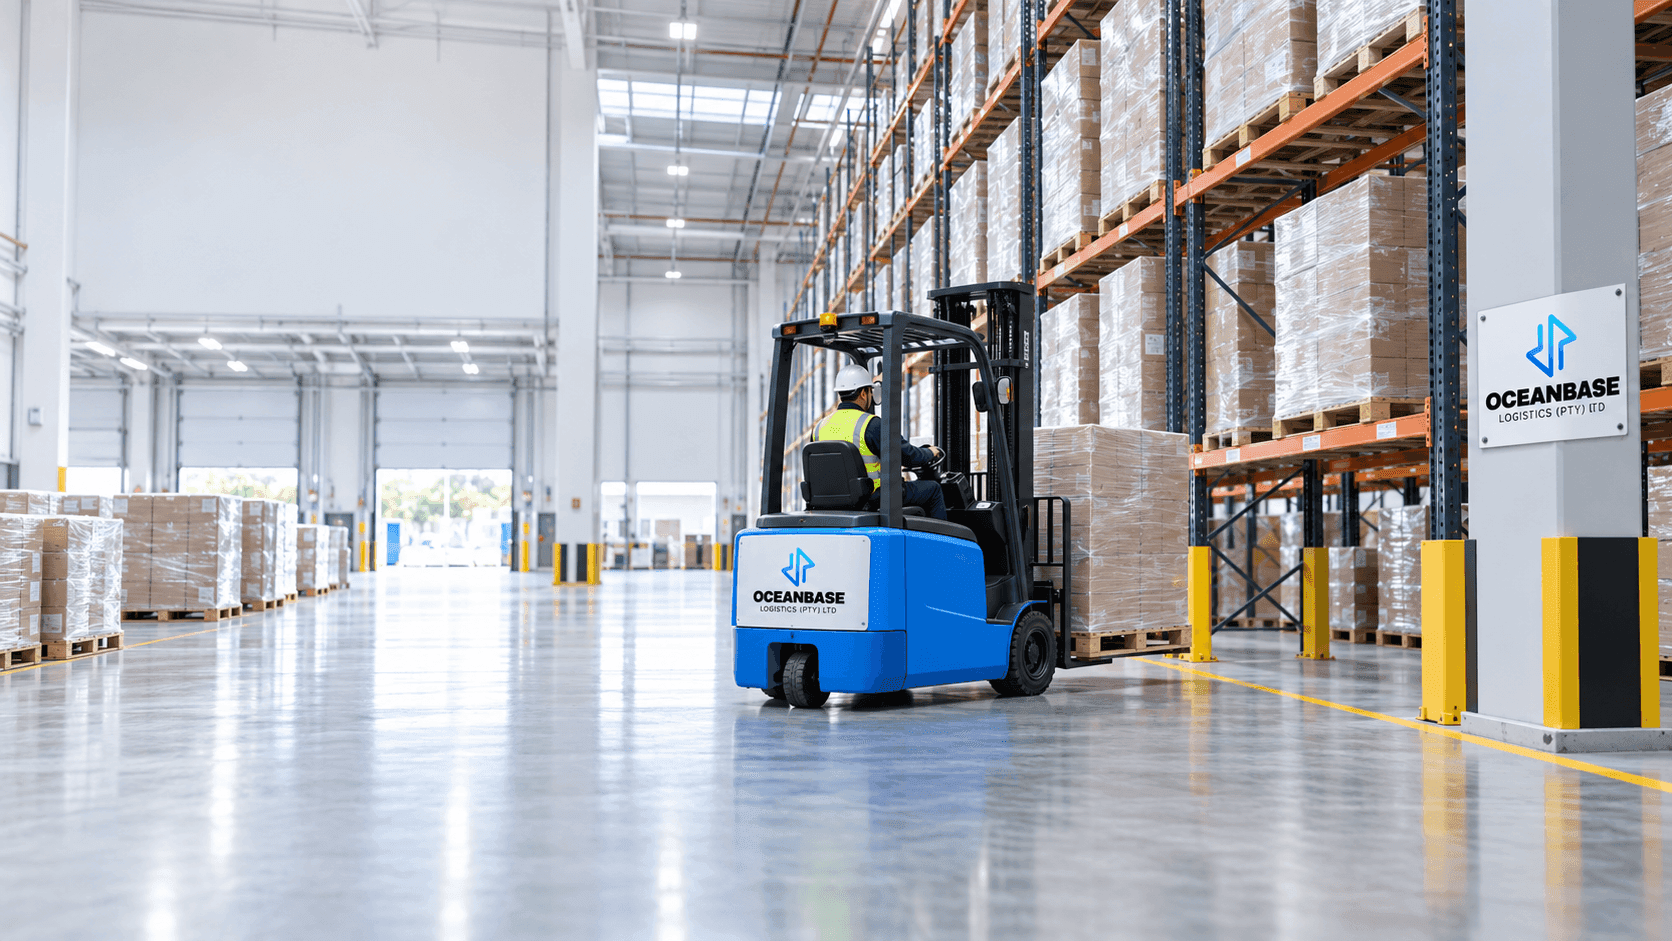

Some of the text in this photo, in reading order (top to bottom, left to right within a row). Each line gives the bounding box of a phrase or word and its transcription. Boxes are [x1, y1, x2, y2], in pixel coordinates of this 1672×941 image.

[1485, 376, 1620, 411] OCEANBASE
[1498, 408, 1552, 423] LOGISTICS
[1556, 404, 1586, 418] (PTY)
[753, 590, 846, 604] OCEANBASE
[760, 605, 837, 614] LOGISTICS (PTY) LTD
